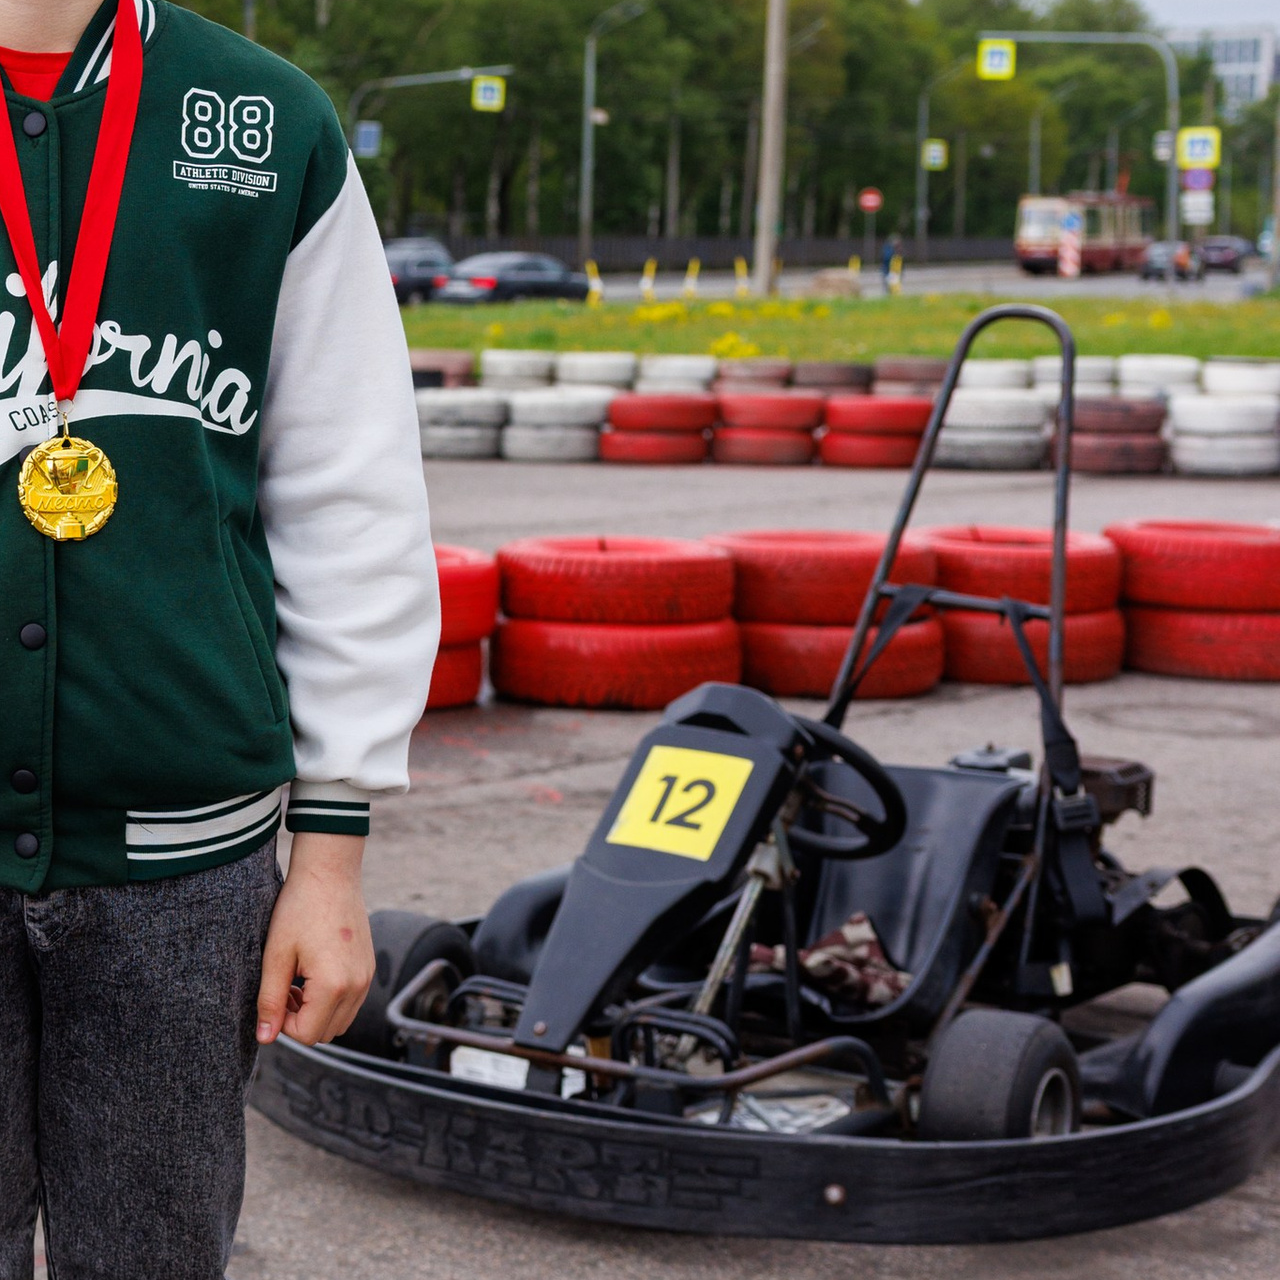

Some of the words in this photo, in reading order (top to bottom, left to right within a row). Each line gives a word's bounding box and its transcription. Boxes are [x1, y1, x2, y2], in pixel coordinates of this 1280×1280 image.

[181, 87, 274, 164] 88
[180, 166, 228, 179] ATHLETIC
[232, 170, 270, 187] DIVISION
[210, 184, 230, 193] STATES
[238, 188, 259, 198] AMERICA
[8, 401, 60, 431] COAS
[649, 774, 716, 831] 12
